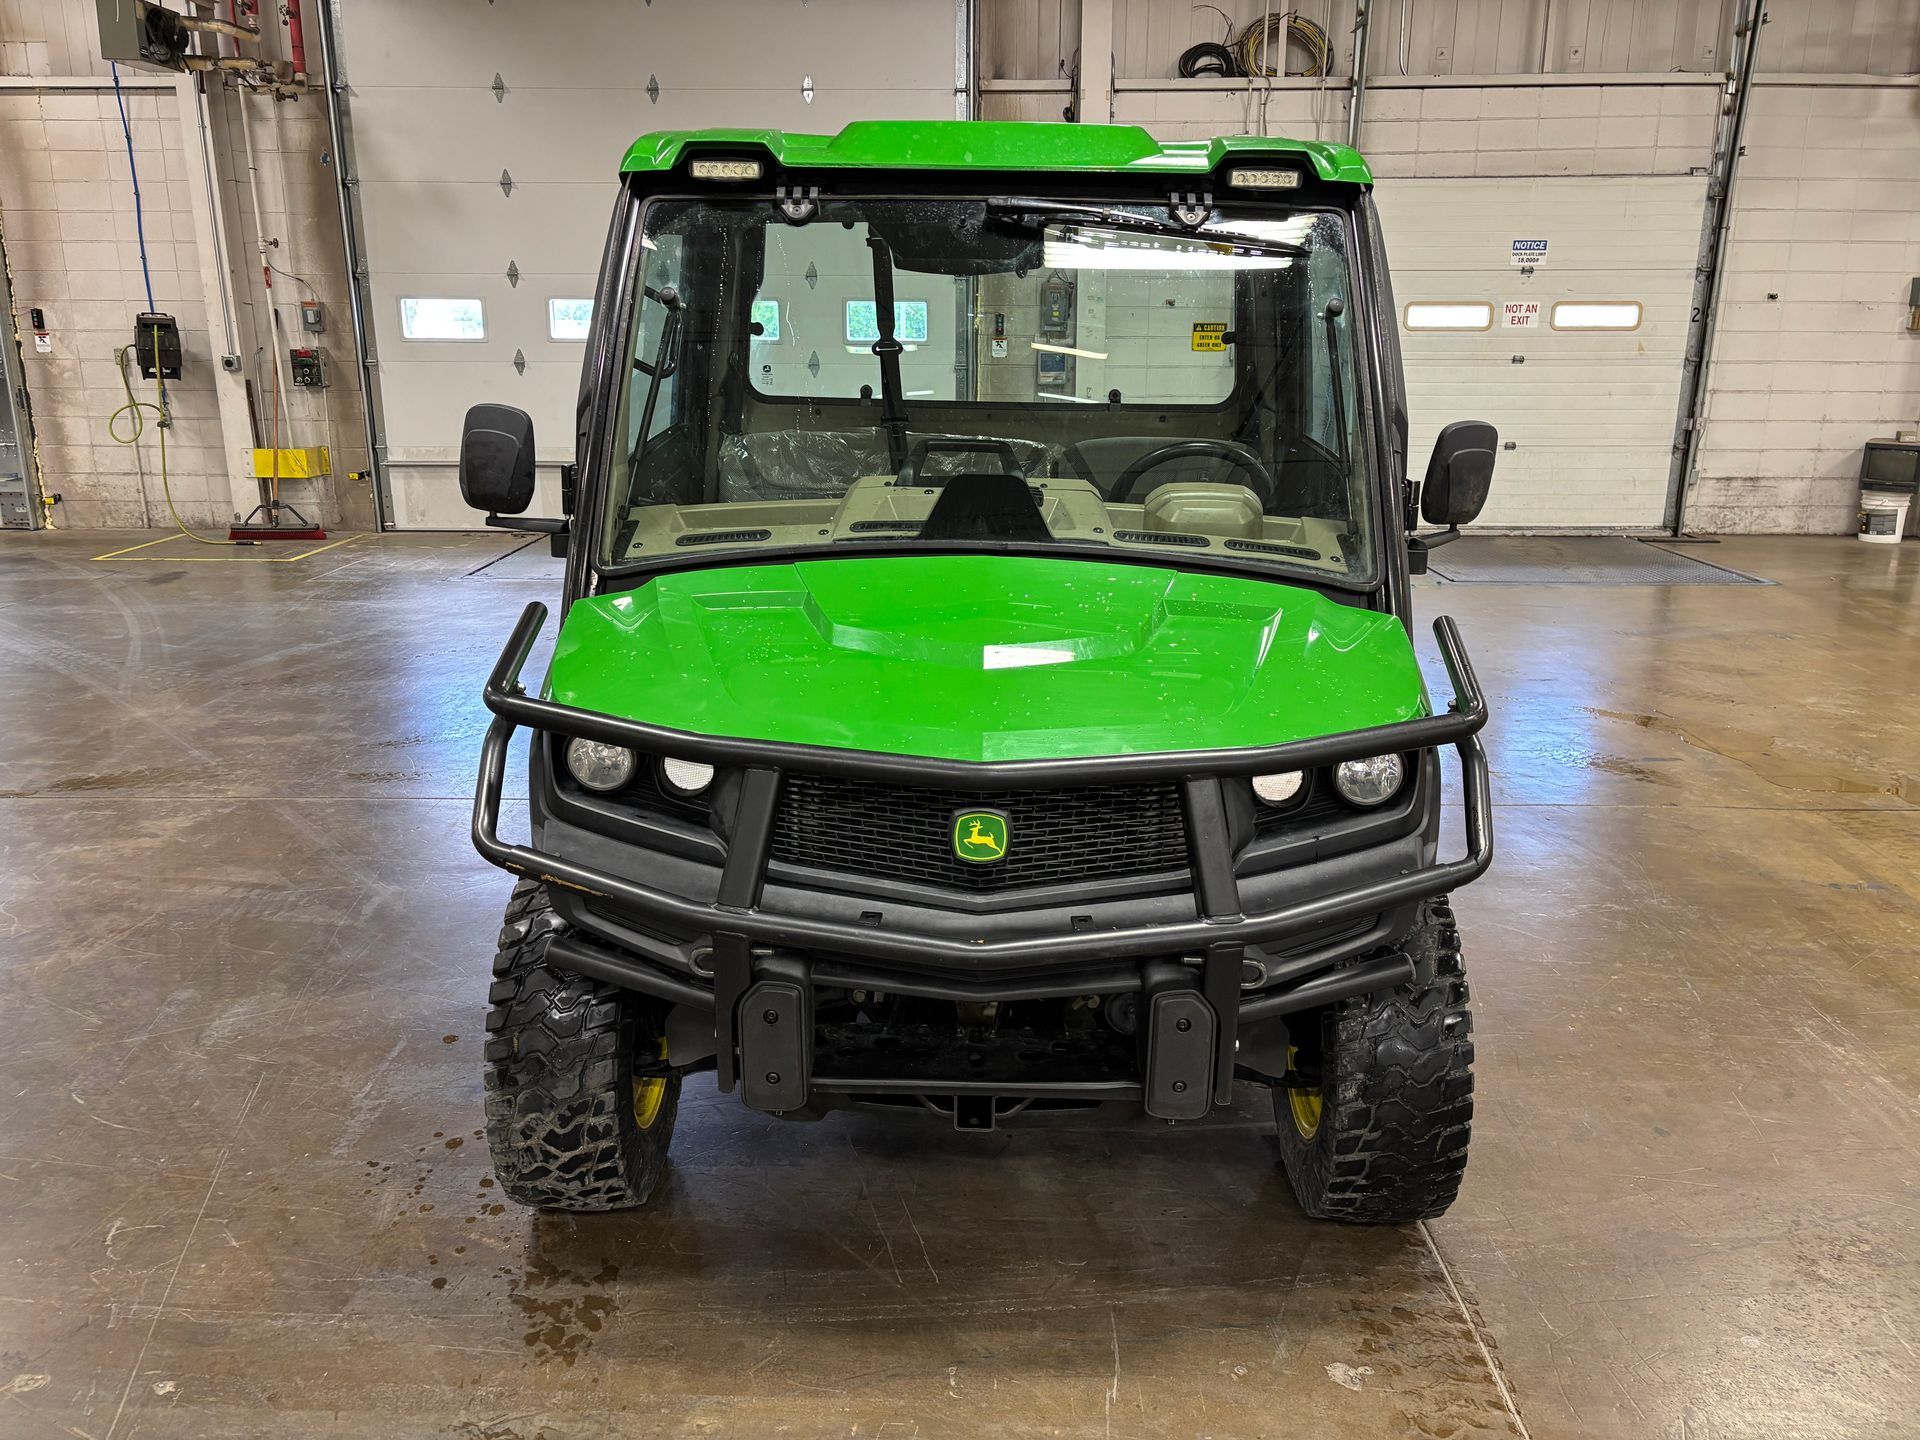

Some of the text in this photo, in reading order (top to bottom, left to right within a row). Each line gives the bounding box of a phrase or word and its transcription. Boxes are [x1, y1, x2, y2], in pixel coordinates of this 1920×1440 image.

[1514, 241, 1546, 250] NOTICE
[1505, 304, 1538, 314] NOT AN
[1692, 307, 1700, 322] 2
[1511, 315, 1530, 325] EXIT
